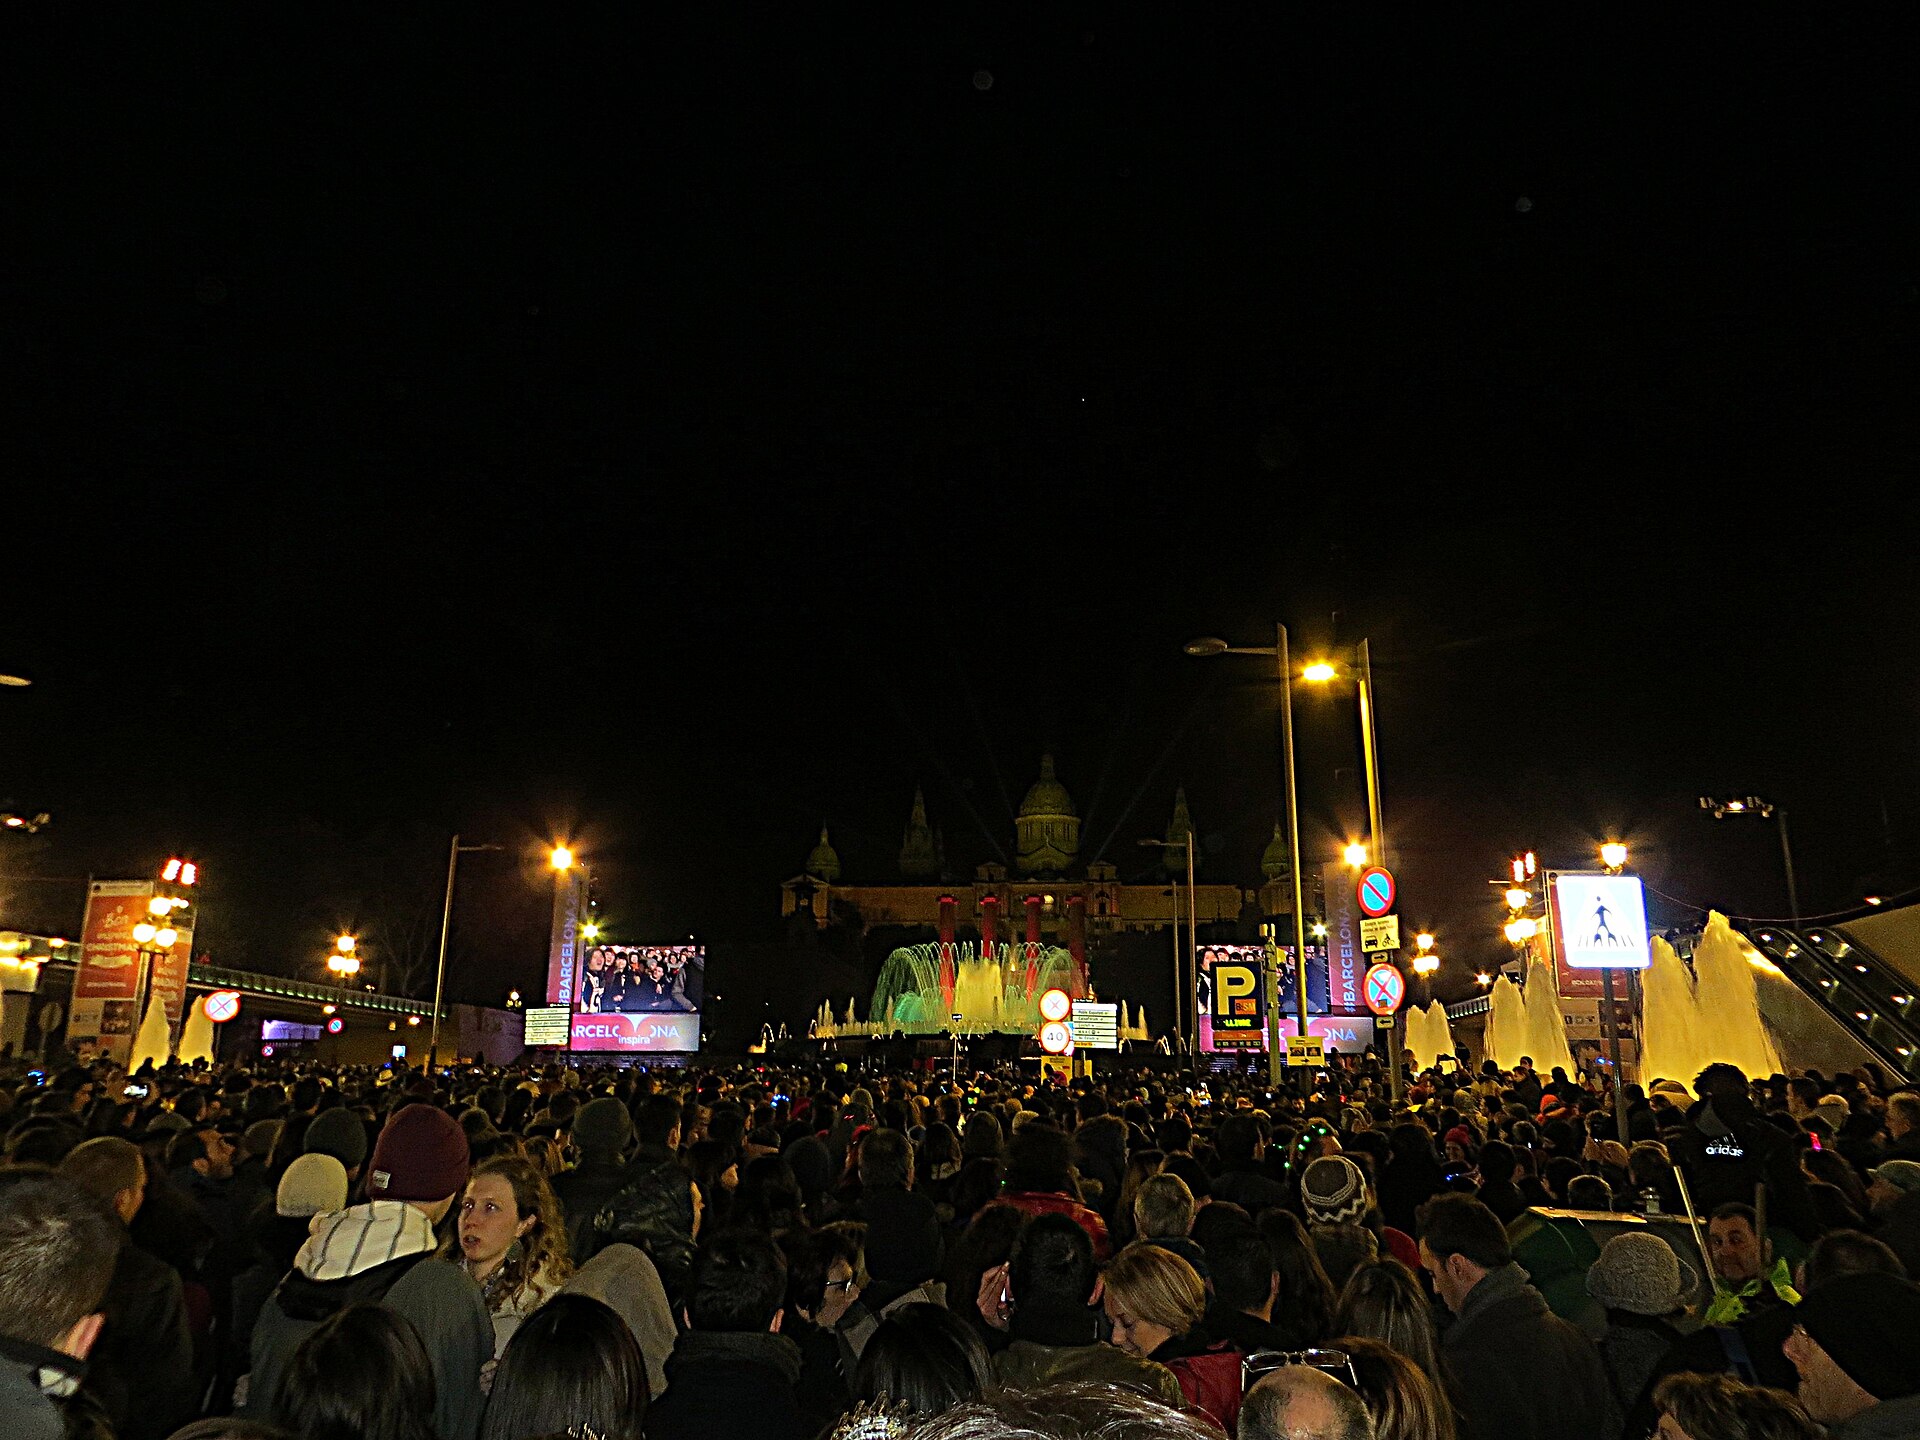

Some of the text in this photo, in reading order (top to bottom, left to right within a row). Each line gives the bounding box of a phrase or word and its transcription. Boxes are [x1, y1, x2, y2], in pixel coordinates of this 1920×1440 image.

[1216, 966, 1256, 1015] P
[618, 1035, 650, 1046] inspira
[1047, 1032, 1063, 1041] 40
[1706, 1144, 1743, 1156] adidas
